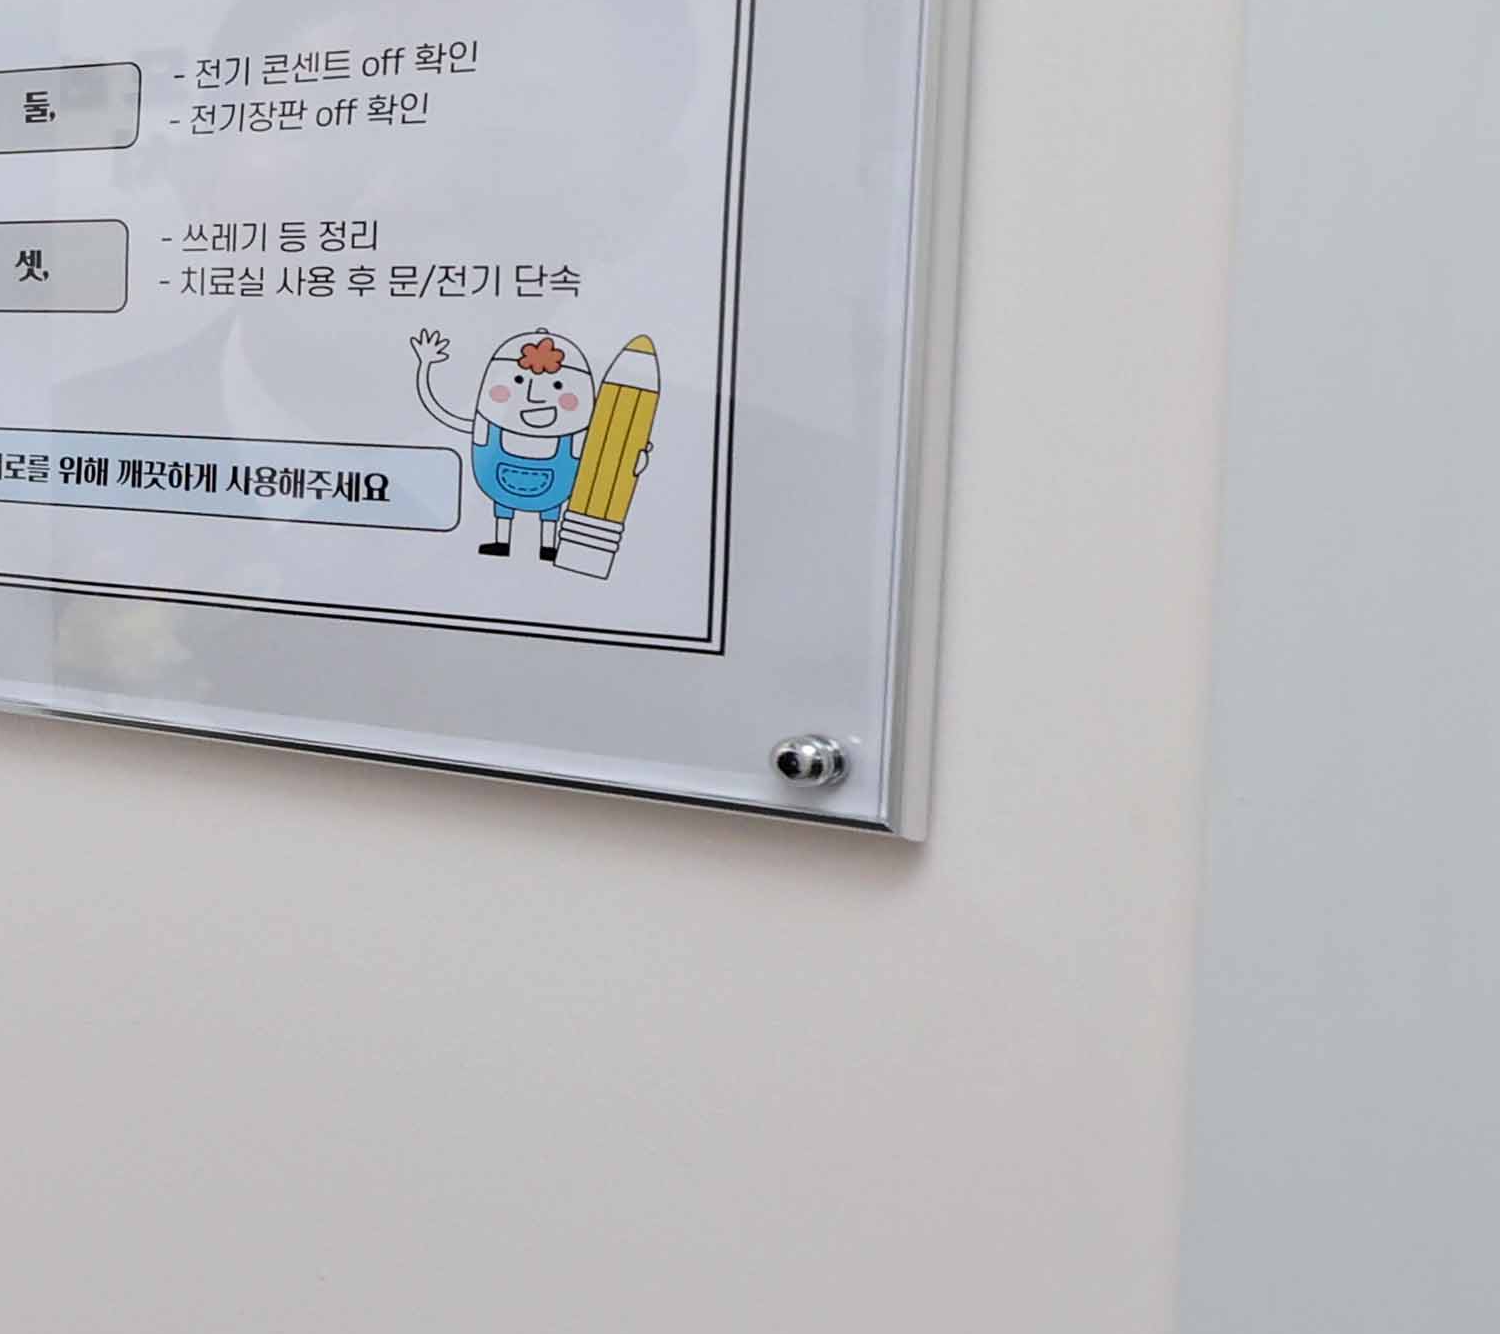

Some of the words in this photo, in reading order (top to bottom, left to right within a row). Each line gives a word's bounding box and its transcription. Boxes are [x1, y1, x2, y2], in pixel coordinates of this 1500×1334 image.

[194, 55, 251, 90] 전기
[260, 49, 352, 86] 콘센트
[360, 46, 406, 78] off
[413, 39, 479, 76] 확인
[22, 90, 57, 125] 둘,
[190, 98, 309, 136] 전기장판
[314, 97, 360, 129] off
[366, 91, 430, 127] 확인
[181, 221, 268, 253] 쓰레기
[278, 220, 308, 254] 등
[318, 219, 379, 253] 정리
[179, 265, 265, 298] 치료실
[275, 265, 337, 299] 사용
[346, 263, 377, 298] 후
[387, 263, 501, 300] 문/전기
[514, 263, 582, 299] 단속
[58, 455, 110, 488] 위해
[115, 458, 219, 494] 깨끗하게
[224, 464, 391, 504] 사용해주세요
